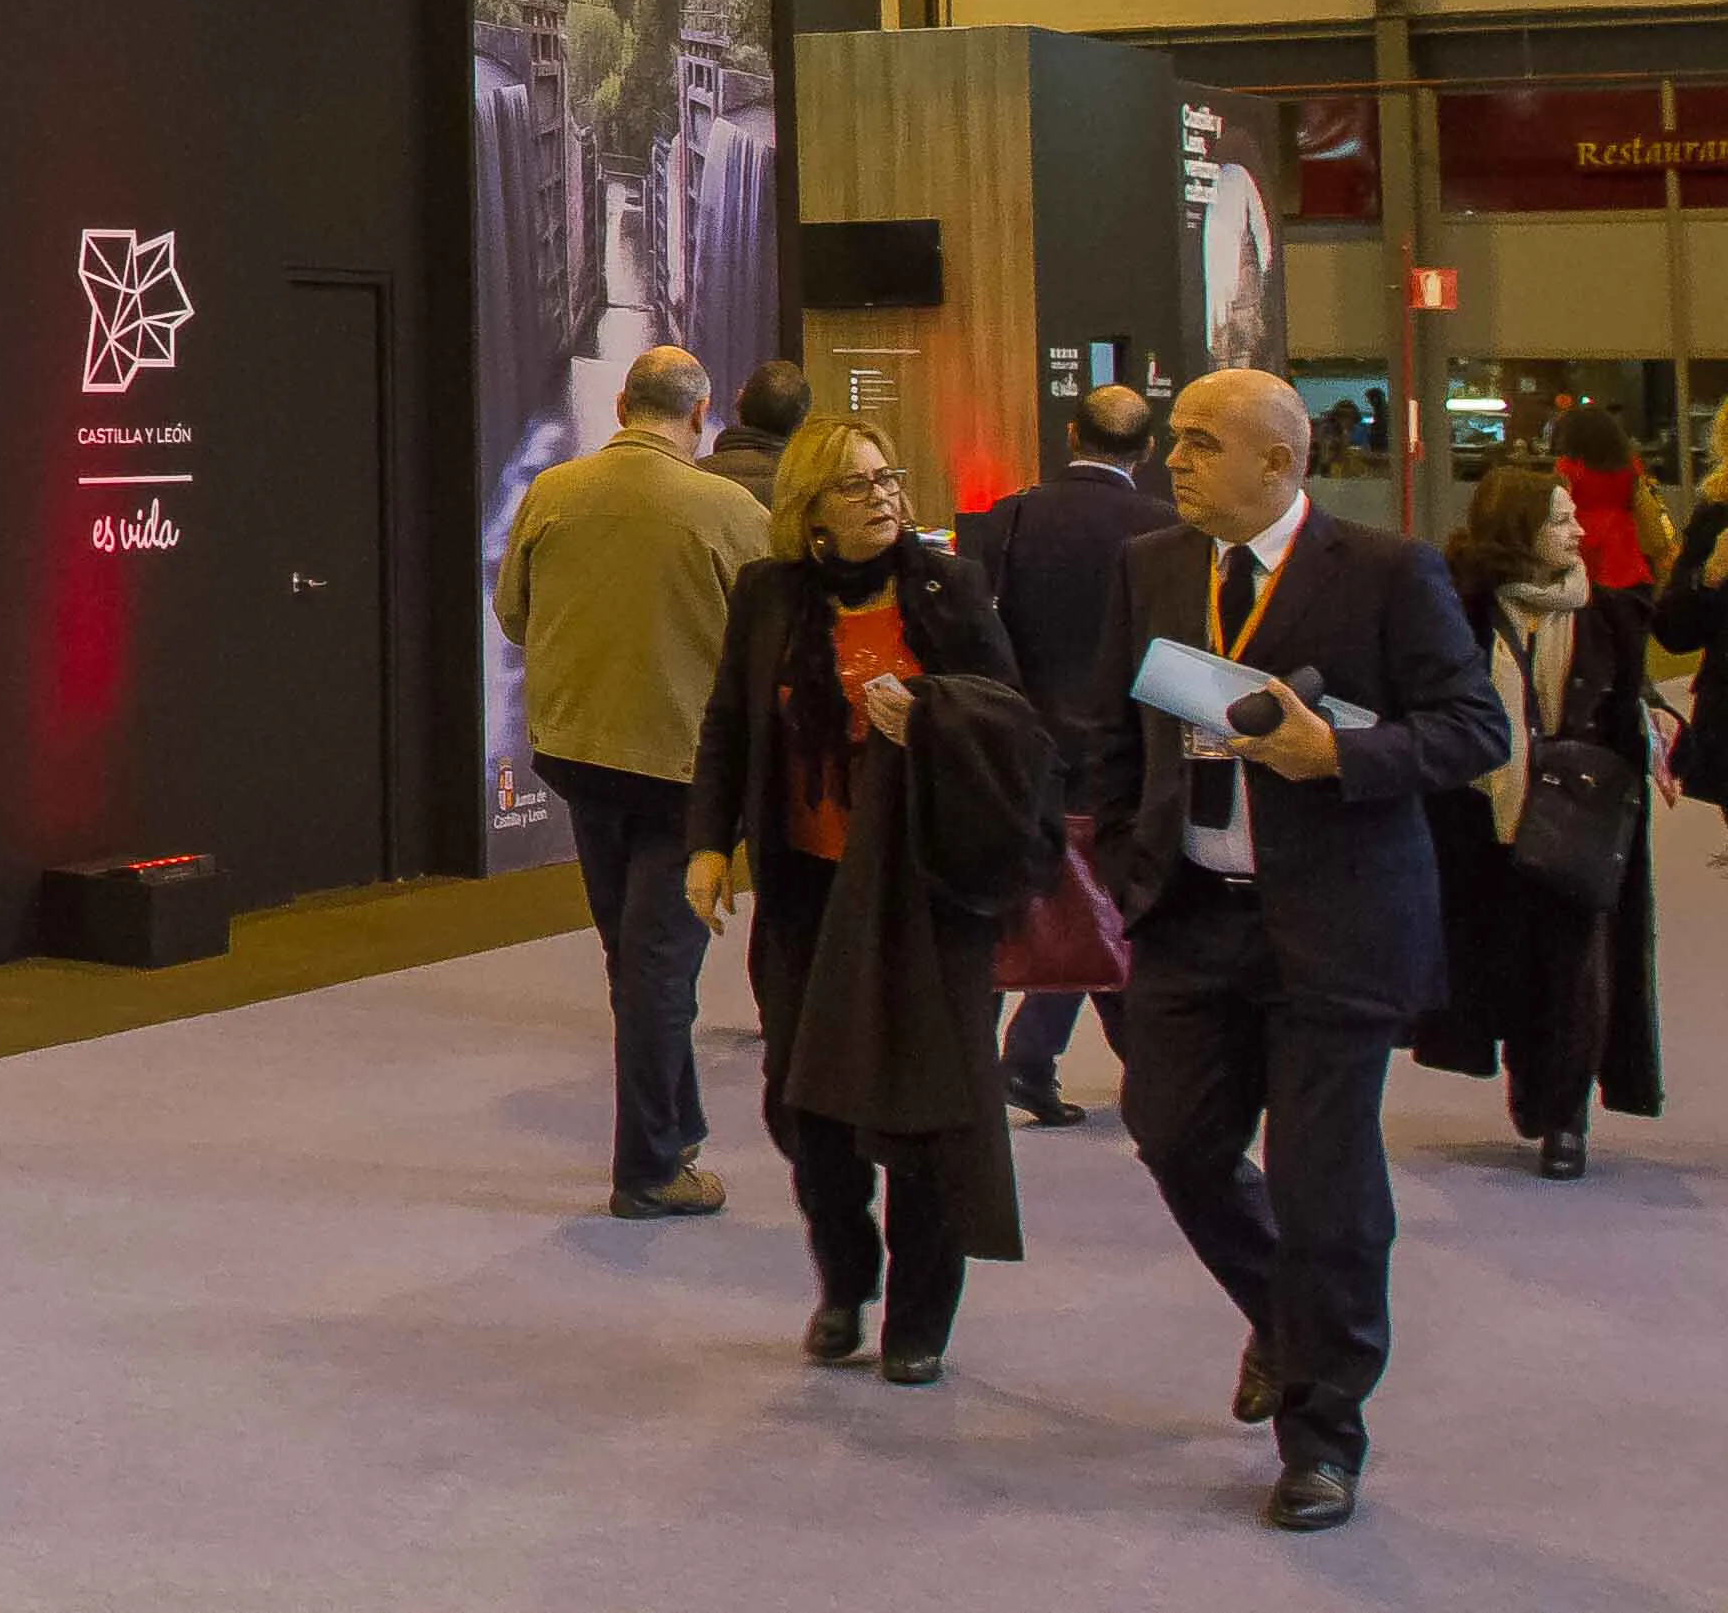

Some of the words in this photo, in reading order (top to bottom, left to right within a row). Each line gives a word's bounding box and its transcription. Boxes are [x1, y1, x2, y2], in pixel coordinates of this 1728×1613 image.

[78, 427, 143, 445] CASTILLA
[145, 427, 154, 444] Y
[157, 422, 192, 443] LEÓN
[92, 515, 116, 553] es
[120, 497, 181, 550] vida
